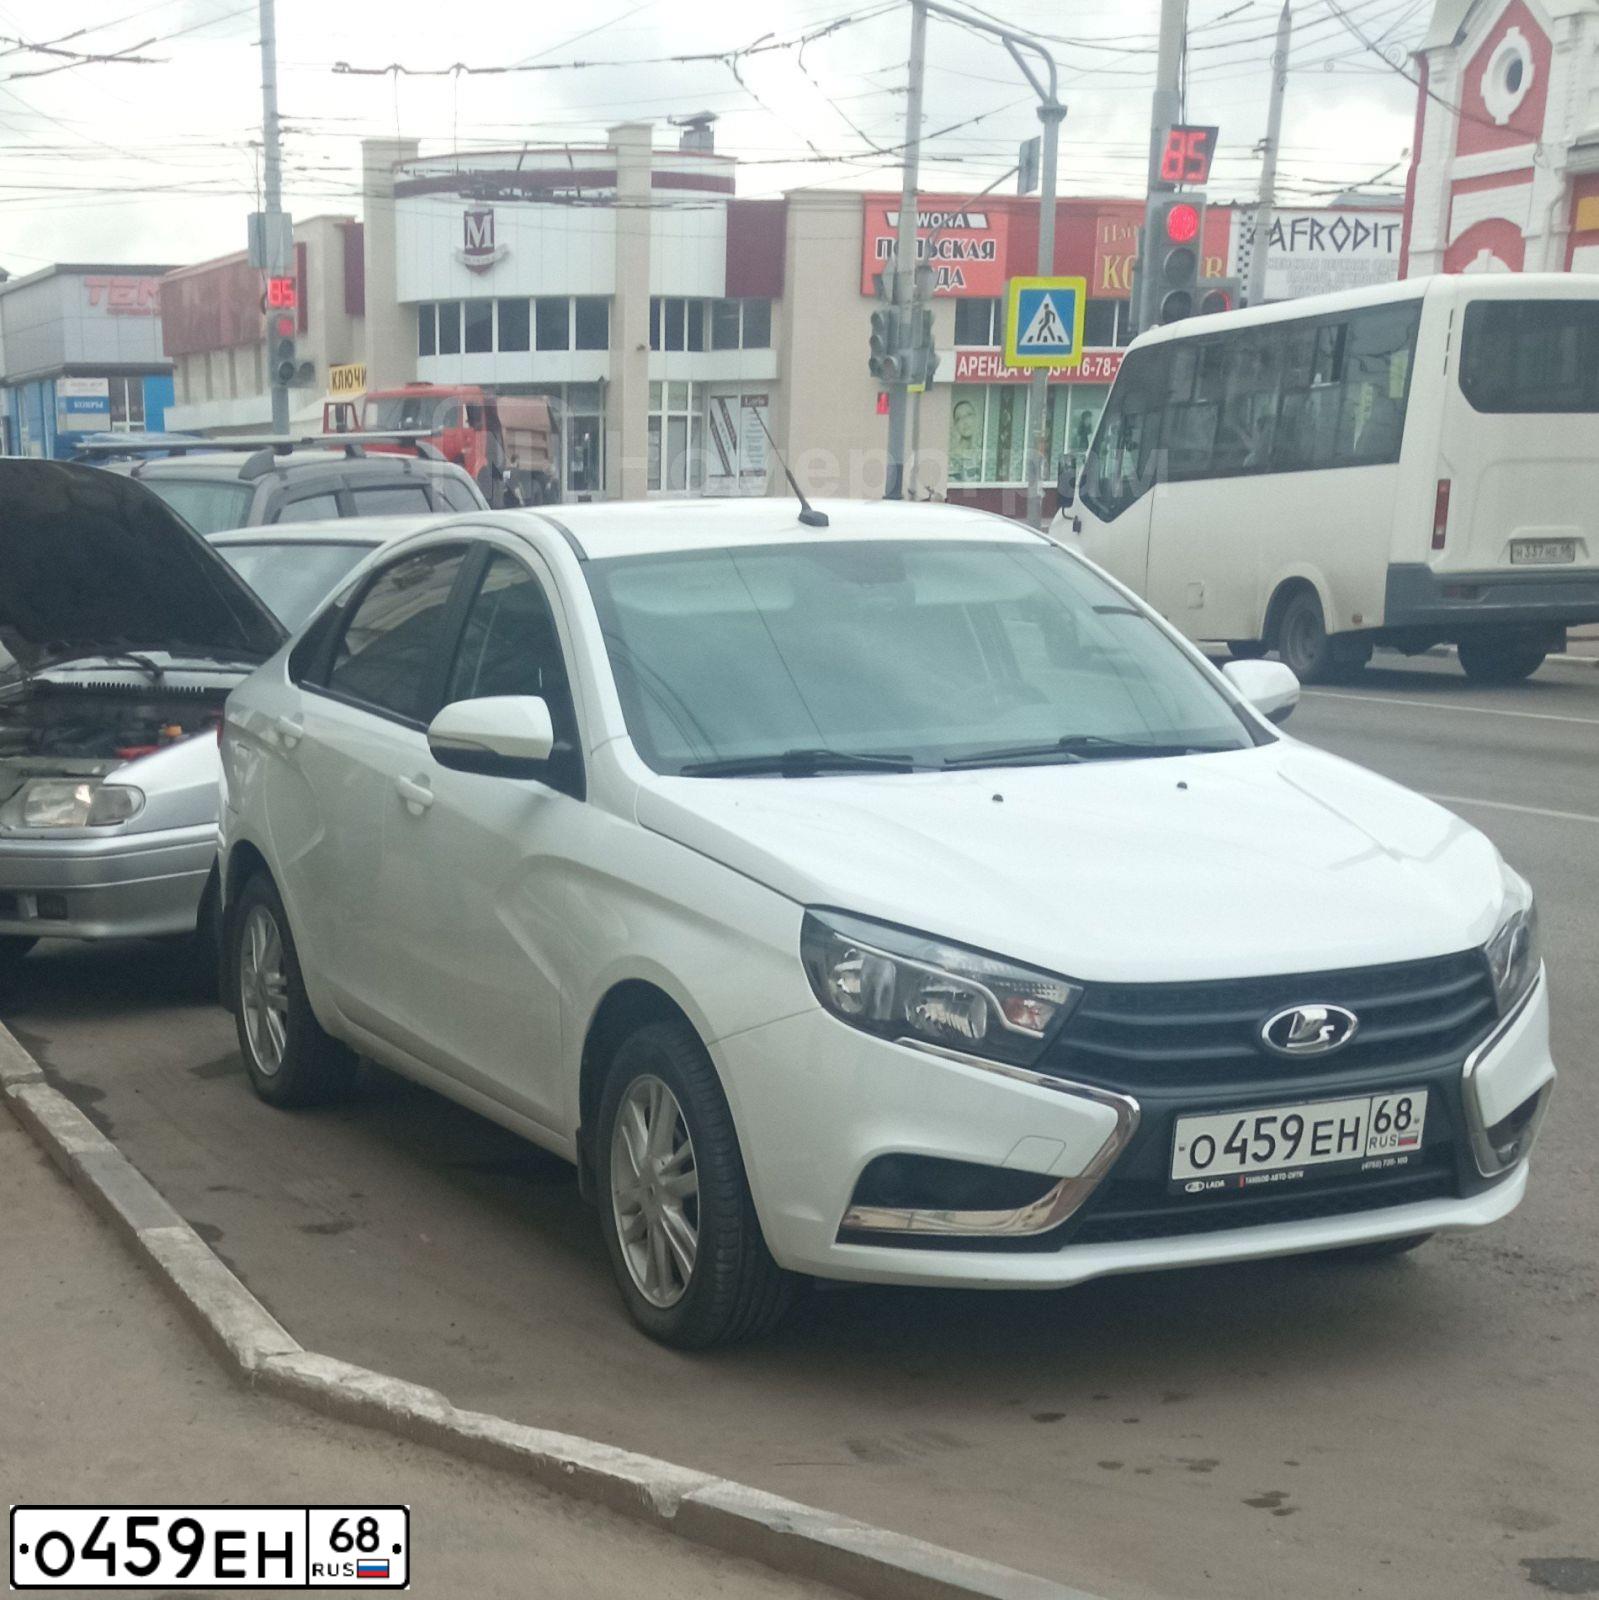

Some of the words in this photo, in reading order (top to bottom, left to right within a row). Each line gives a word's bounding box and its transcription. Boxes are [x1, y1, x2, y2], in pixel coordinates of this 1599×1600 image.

[1160, 129, 1207, 180] 85
[268, 279, 294, 305] 85
[332, 367, 367, 391] КЛЮЧИ
[1189, 1114, 1361, 1169] О459ЕН
[1373, 1097, 1412, 1134] 68
[1368, 1133, 1397, 1149] RUS
[1205, 1179, 1226, 1190] LADA
